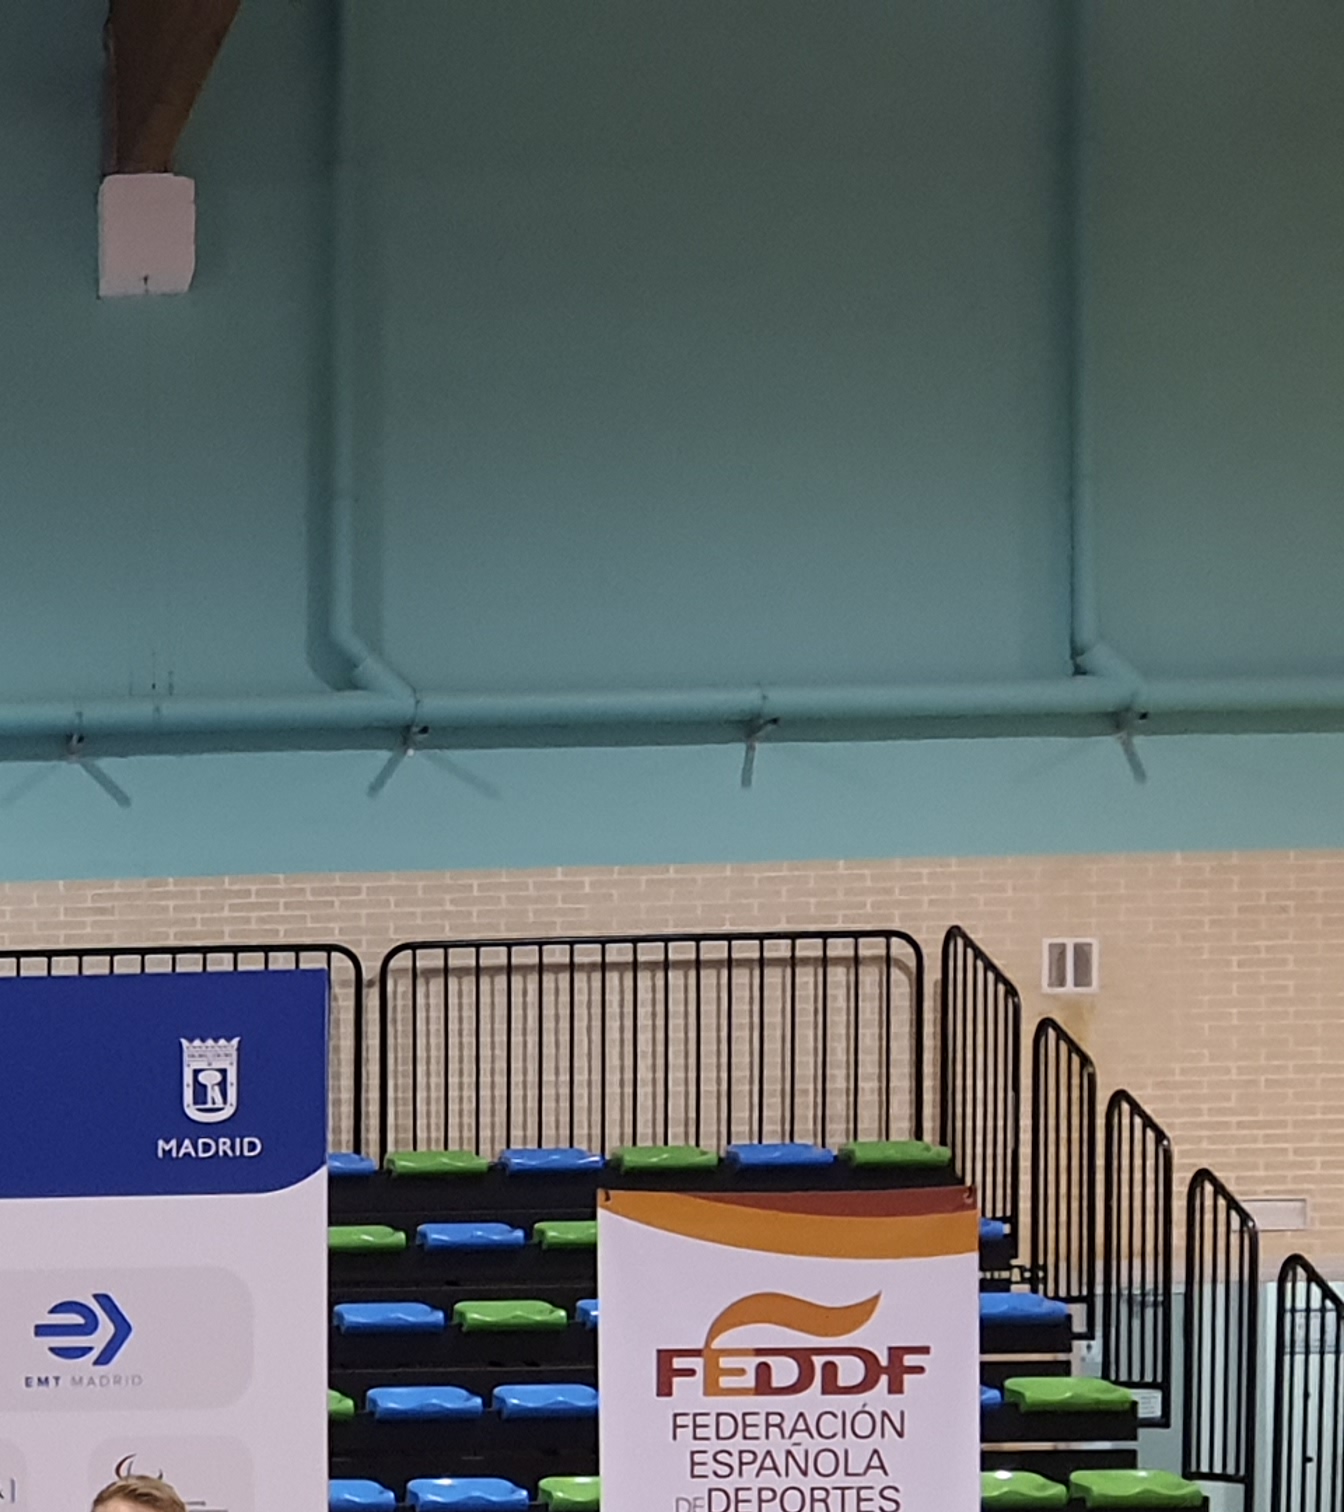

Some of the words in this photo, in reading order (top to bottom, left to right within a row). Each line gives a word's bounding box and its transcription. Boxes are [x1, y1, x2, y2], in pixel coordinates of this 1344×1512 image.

[157, 1137, 262, 1158] MADRID
[24, 1376, 62, 1388] EMT
[70, 1374, 143, 1388] MADRID
[655, 1345, 931, 1398] FEDDF
[671, 1404, 906, 1442] FEDERACIÓN
[689, 1442, 888, 1479] ESPAÑOLA
